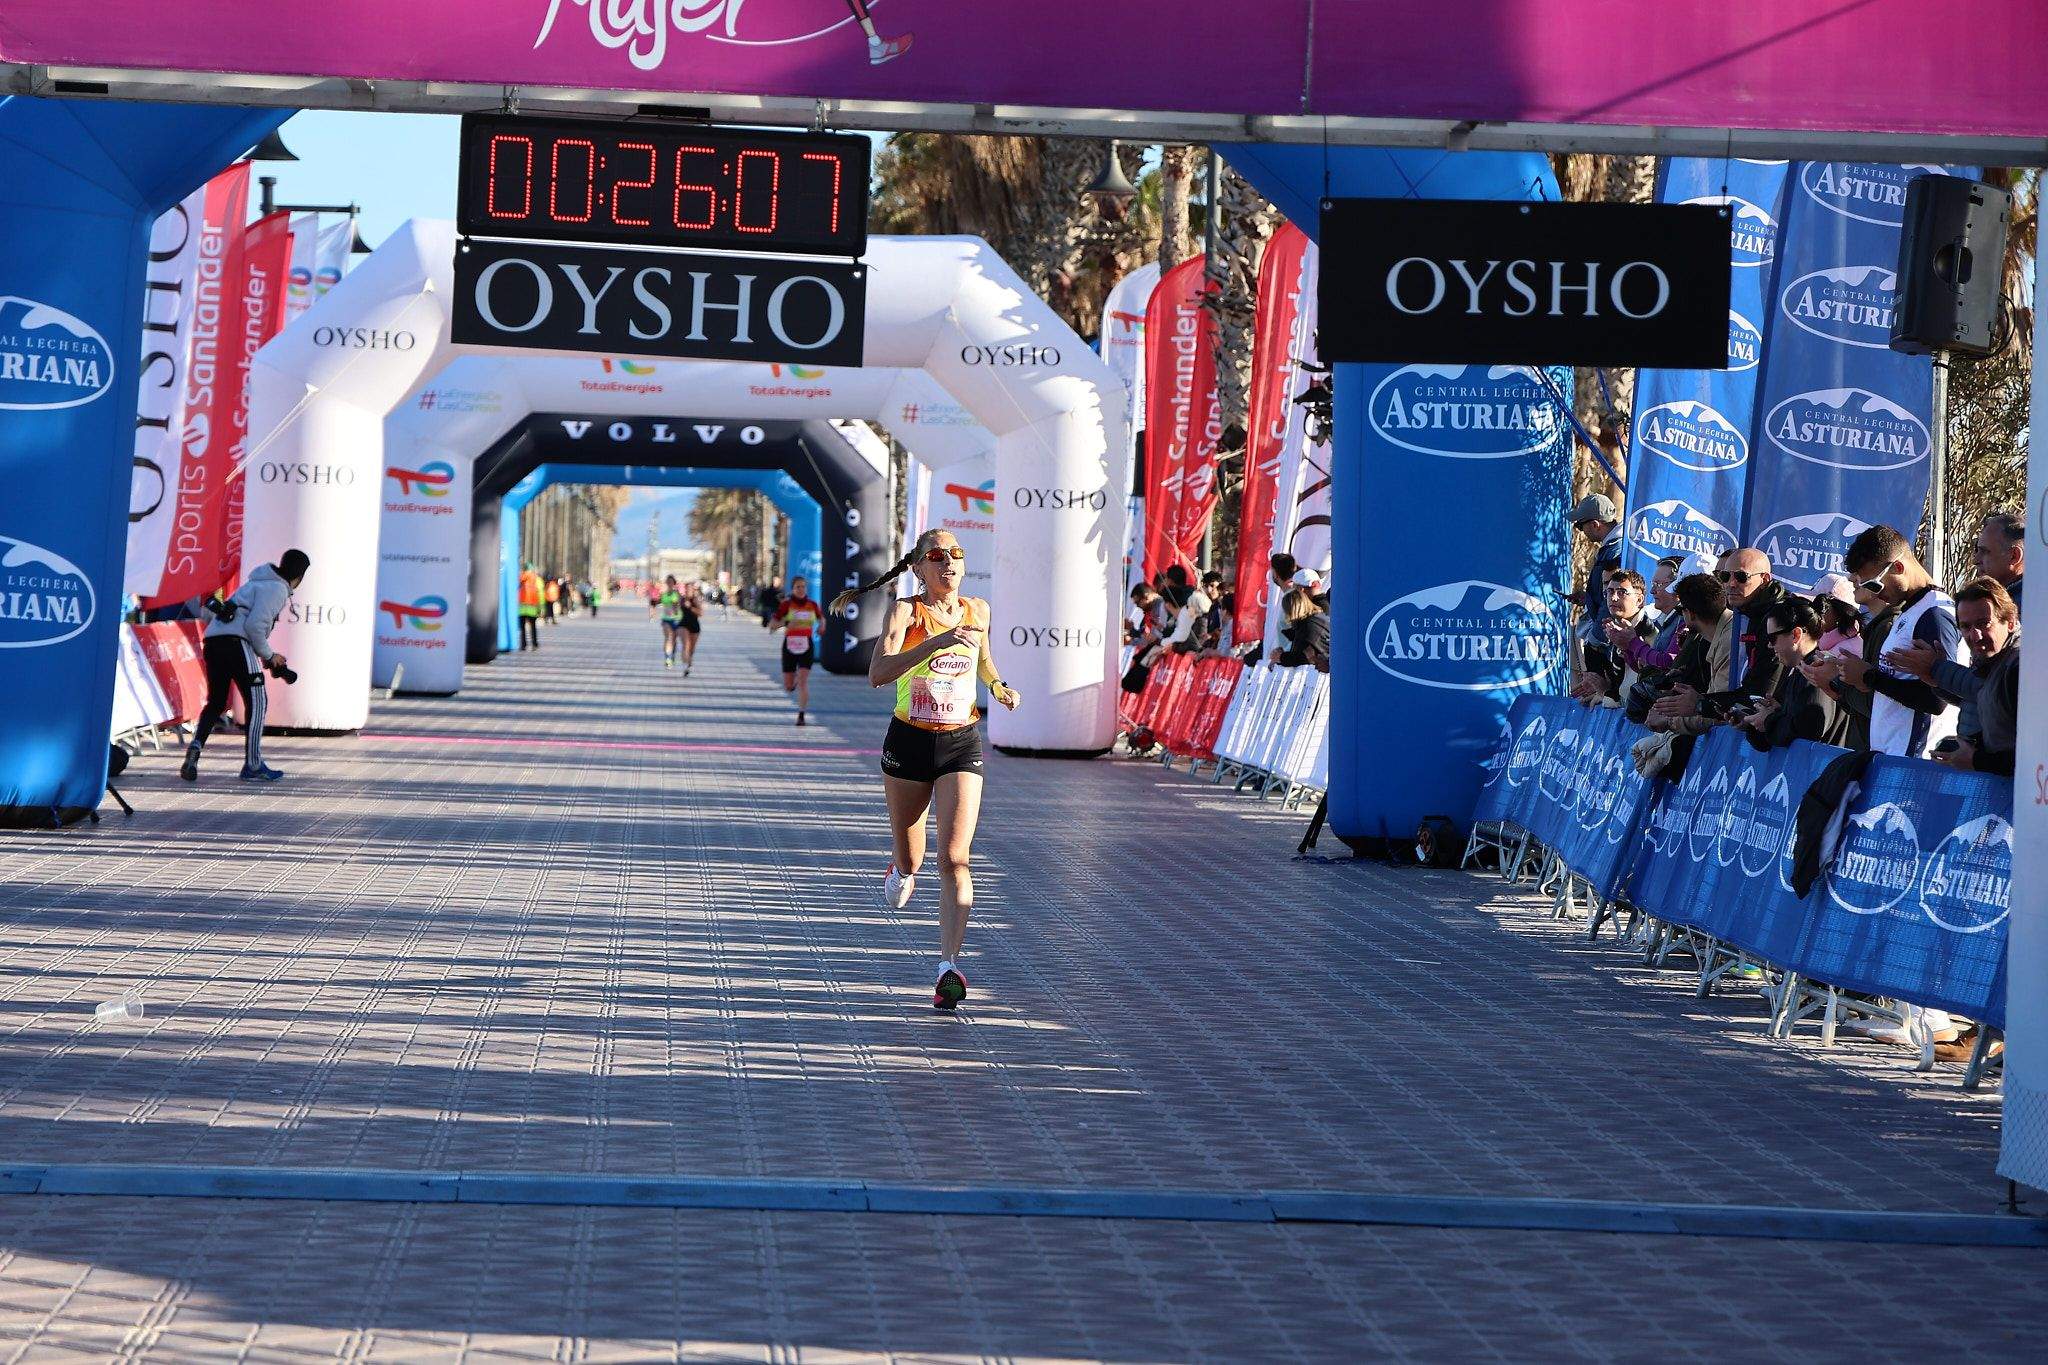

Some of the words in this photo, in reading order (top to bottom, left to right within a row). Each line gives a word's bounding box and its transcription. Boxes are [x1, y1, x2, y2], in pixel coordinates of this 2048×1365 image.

[488, 135, 841, 233] 00:26:07
[1812, 162, 1907, 207] ASTURI
[1844, 165, 1898, 181] CENTRAL
[1386, 257, 1670, 319] OYSHO
[1823, 287, 1877, 302] CENTRAL
[185, 219, 223, 408] Santander
[475, 258, 845, 350] OYSHO
[1792, 286, 1896, 330] ASTURI
[27, 337, 97, 355] LECHERA
[233, 263, 267, 429] Satander
[313, 326, 415, 351] OYSHO
[961, 345, 1061, 366] OYSHO
[0, 352, 100, 388] RIANA
[1168, 304, 1198, 460] Santander
[580, 380, 663, 395] TotalEnergies
[749, 385, 832, 398] TotalEnergies
[1414, 386, 1487, 398] CENTRAL
[560, 419, 766, 446] VOLVO
[1776, 409, 1917, 457] ASTURIANA
[1805, 410, 1860, 425] CENTRAL
[1864, 418, 1915, 433] LECHERA
[1643, 416, 1738, 462] ASTURIANA
[260, 462, 355, 485] OYSHO
[1014, 487, 1107, 511] OYSHO
[168, 465, 206, 576] Sports
[1789, 535, 1842, 548] CENTRAL
[1765, 535, 1850, 574] ASTUR
[8, 575, 78, 591] LECHERA
[844, 507, 862, 653] VOLVO
[277, 603, 346, 625] SHO
[1411, 617, 1484, 629] CENTRAL
[1010, 625, 1102, 648] OYSHO
[1377, 618, 1552, 662] ASTURIANA
[932, 658, 970, 670] Serrano
